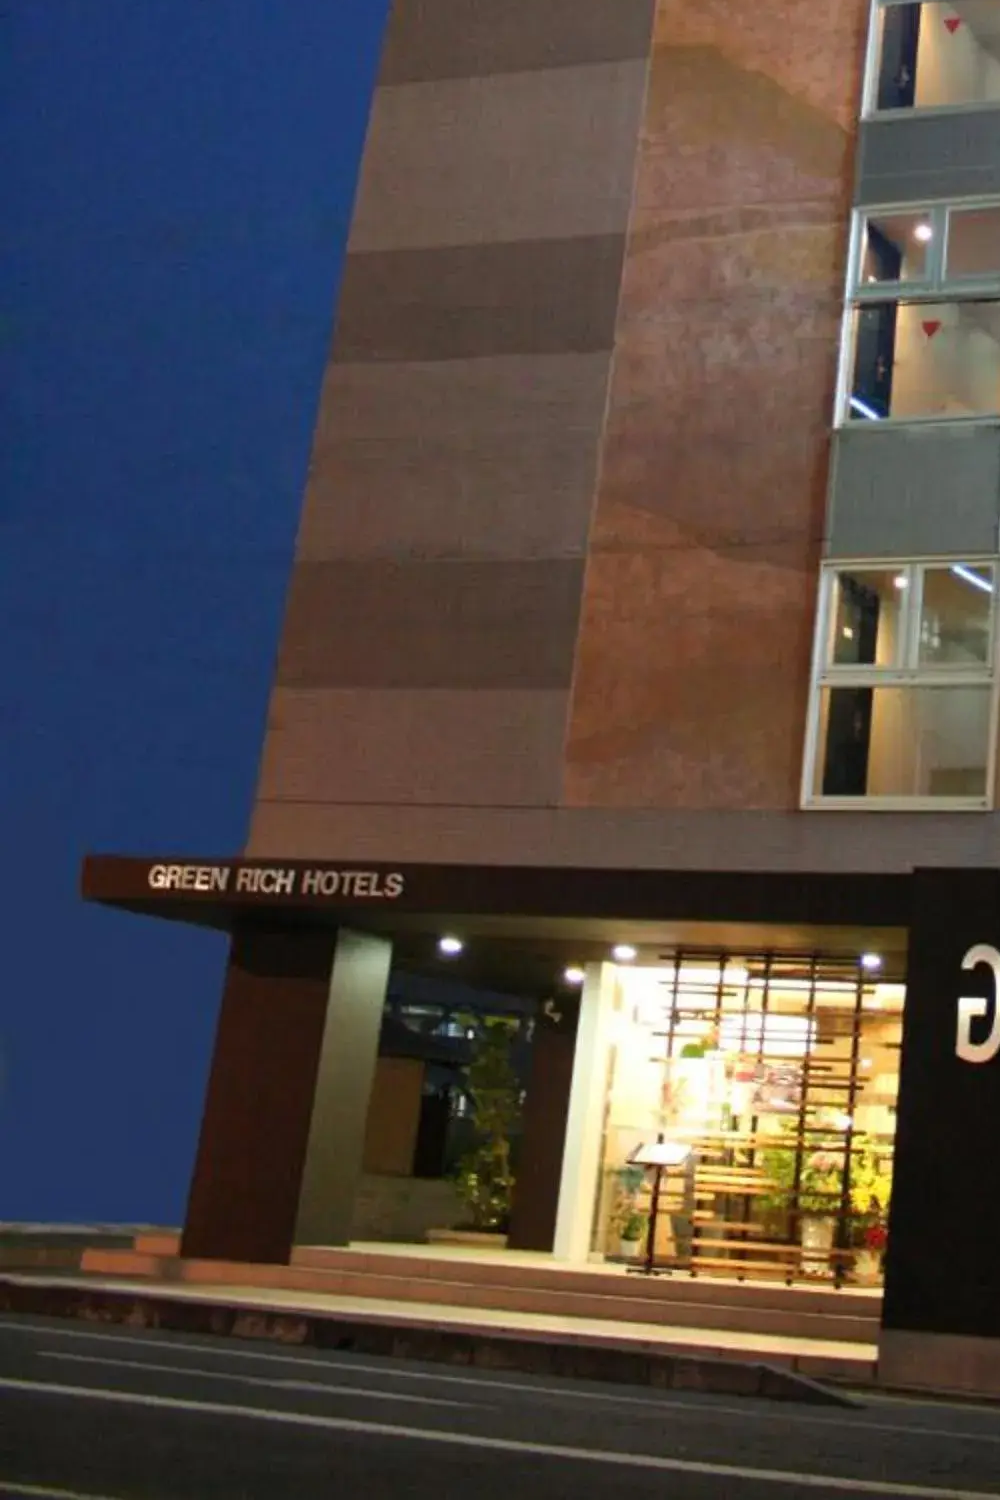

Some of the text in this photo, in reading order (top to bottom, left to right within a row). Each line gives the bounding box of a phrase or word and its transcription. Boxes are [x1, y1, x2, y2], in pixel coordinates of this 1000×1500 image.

[148, 864, 404, 897] GREEN RICH HOTELS
